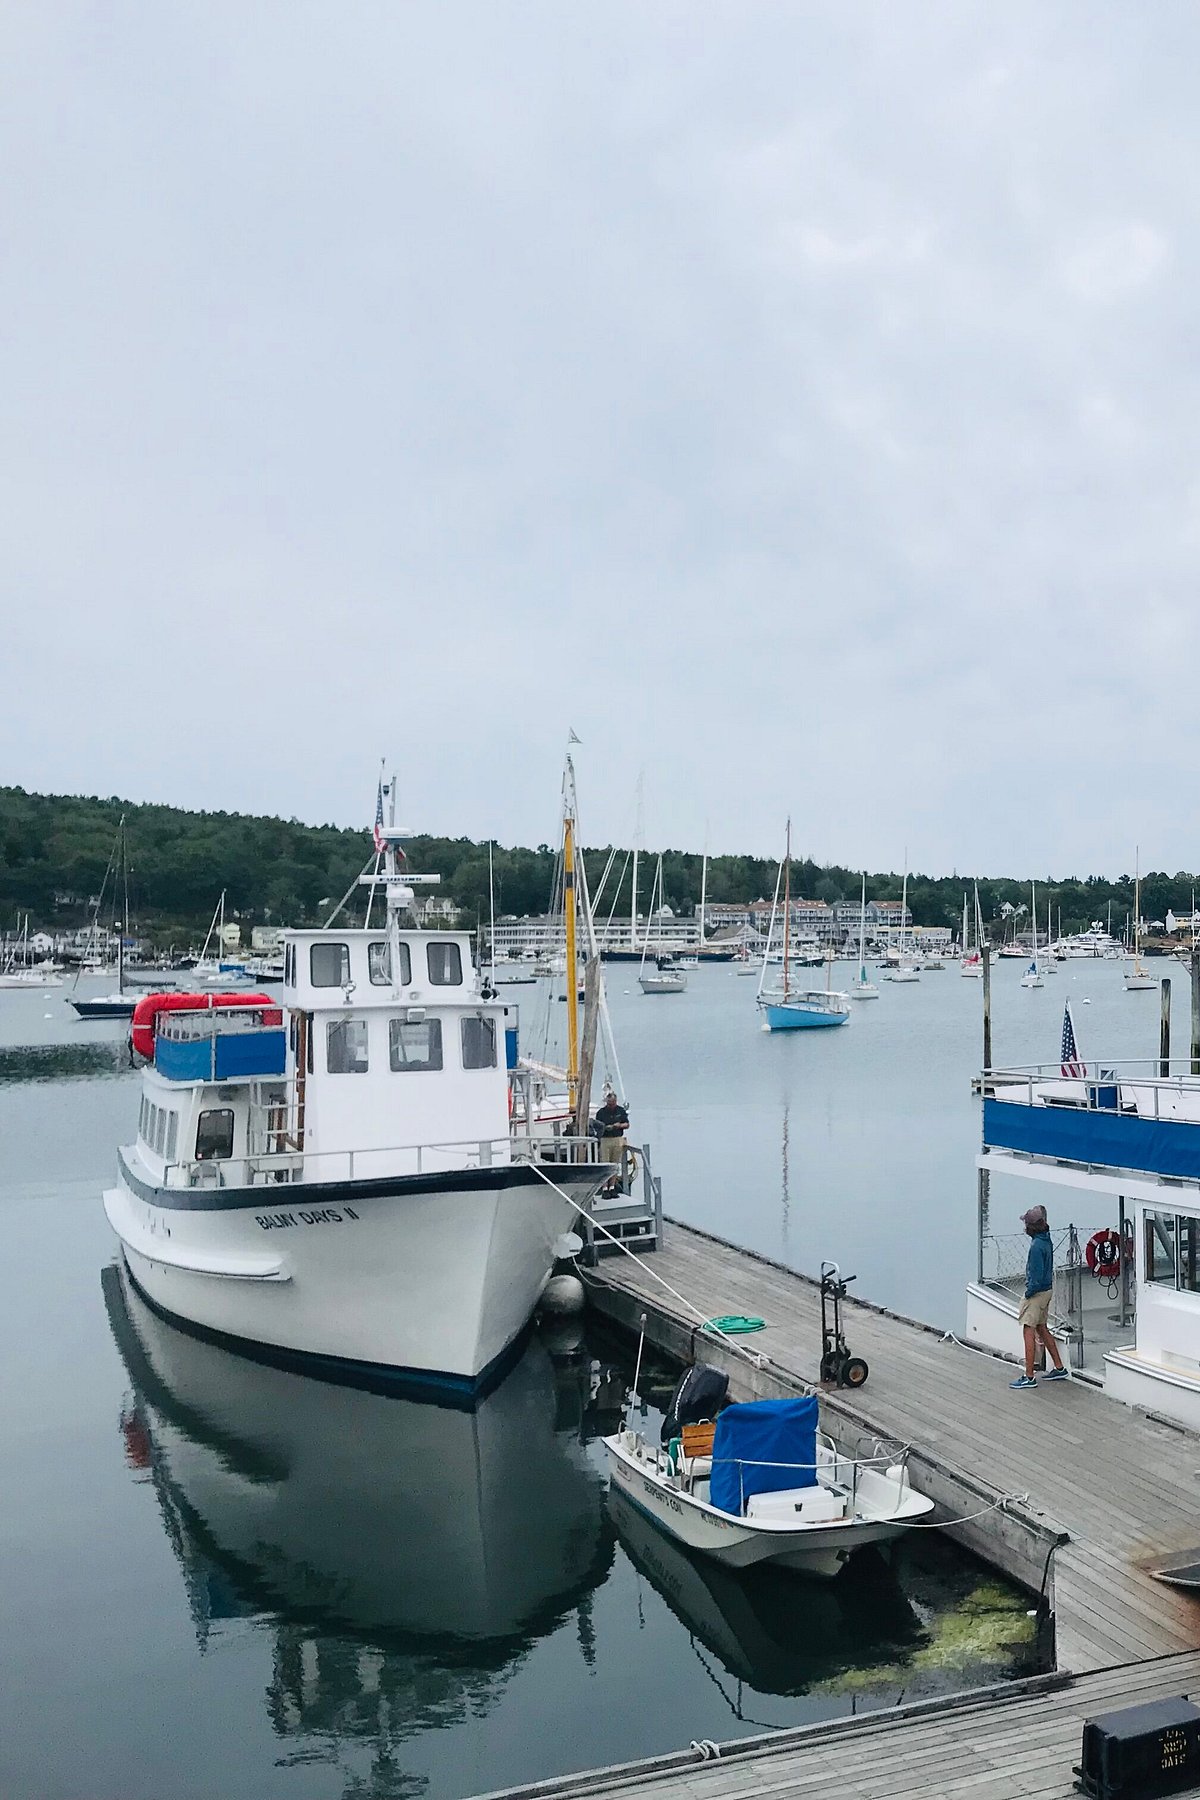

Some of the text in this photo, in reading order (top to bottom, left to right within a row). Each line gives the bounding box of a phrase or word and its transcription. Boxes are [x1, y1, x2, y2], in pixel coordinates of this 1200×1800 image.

[255, 1207, 360, 1230] BALMY DAYS II
